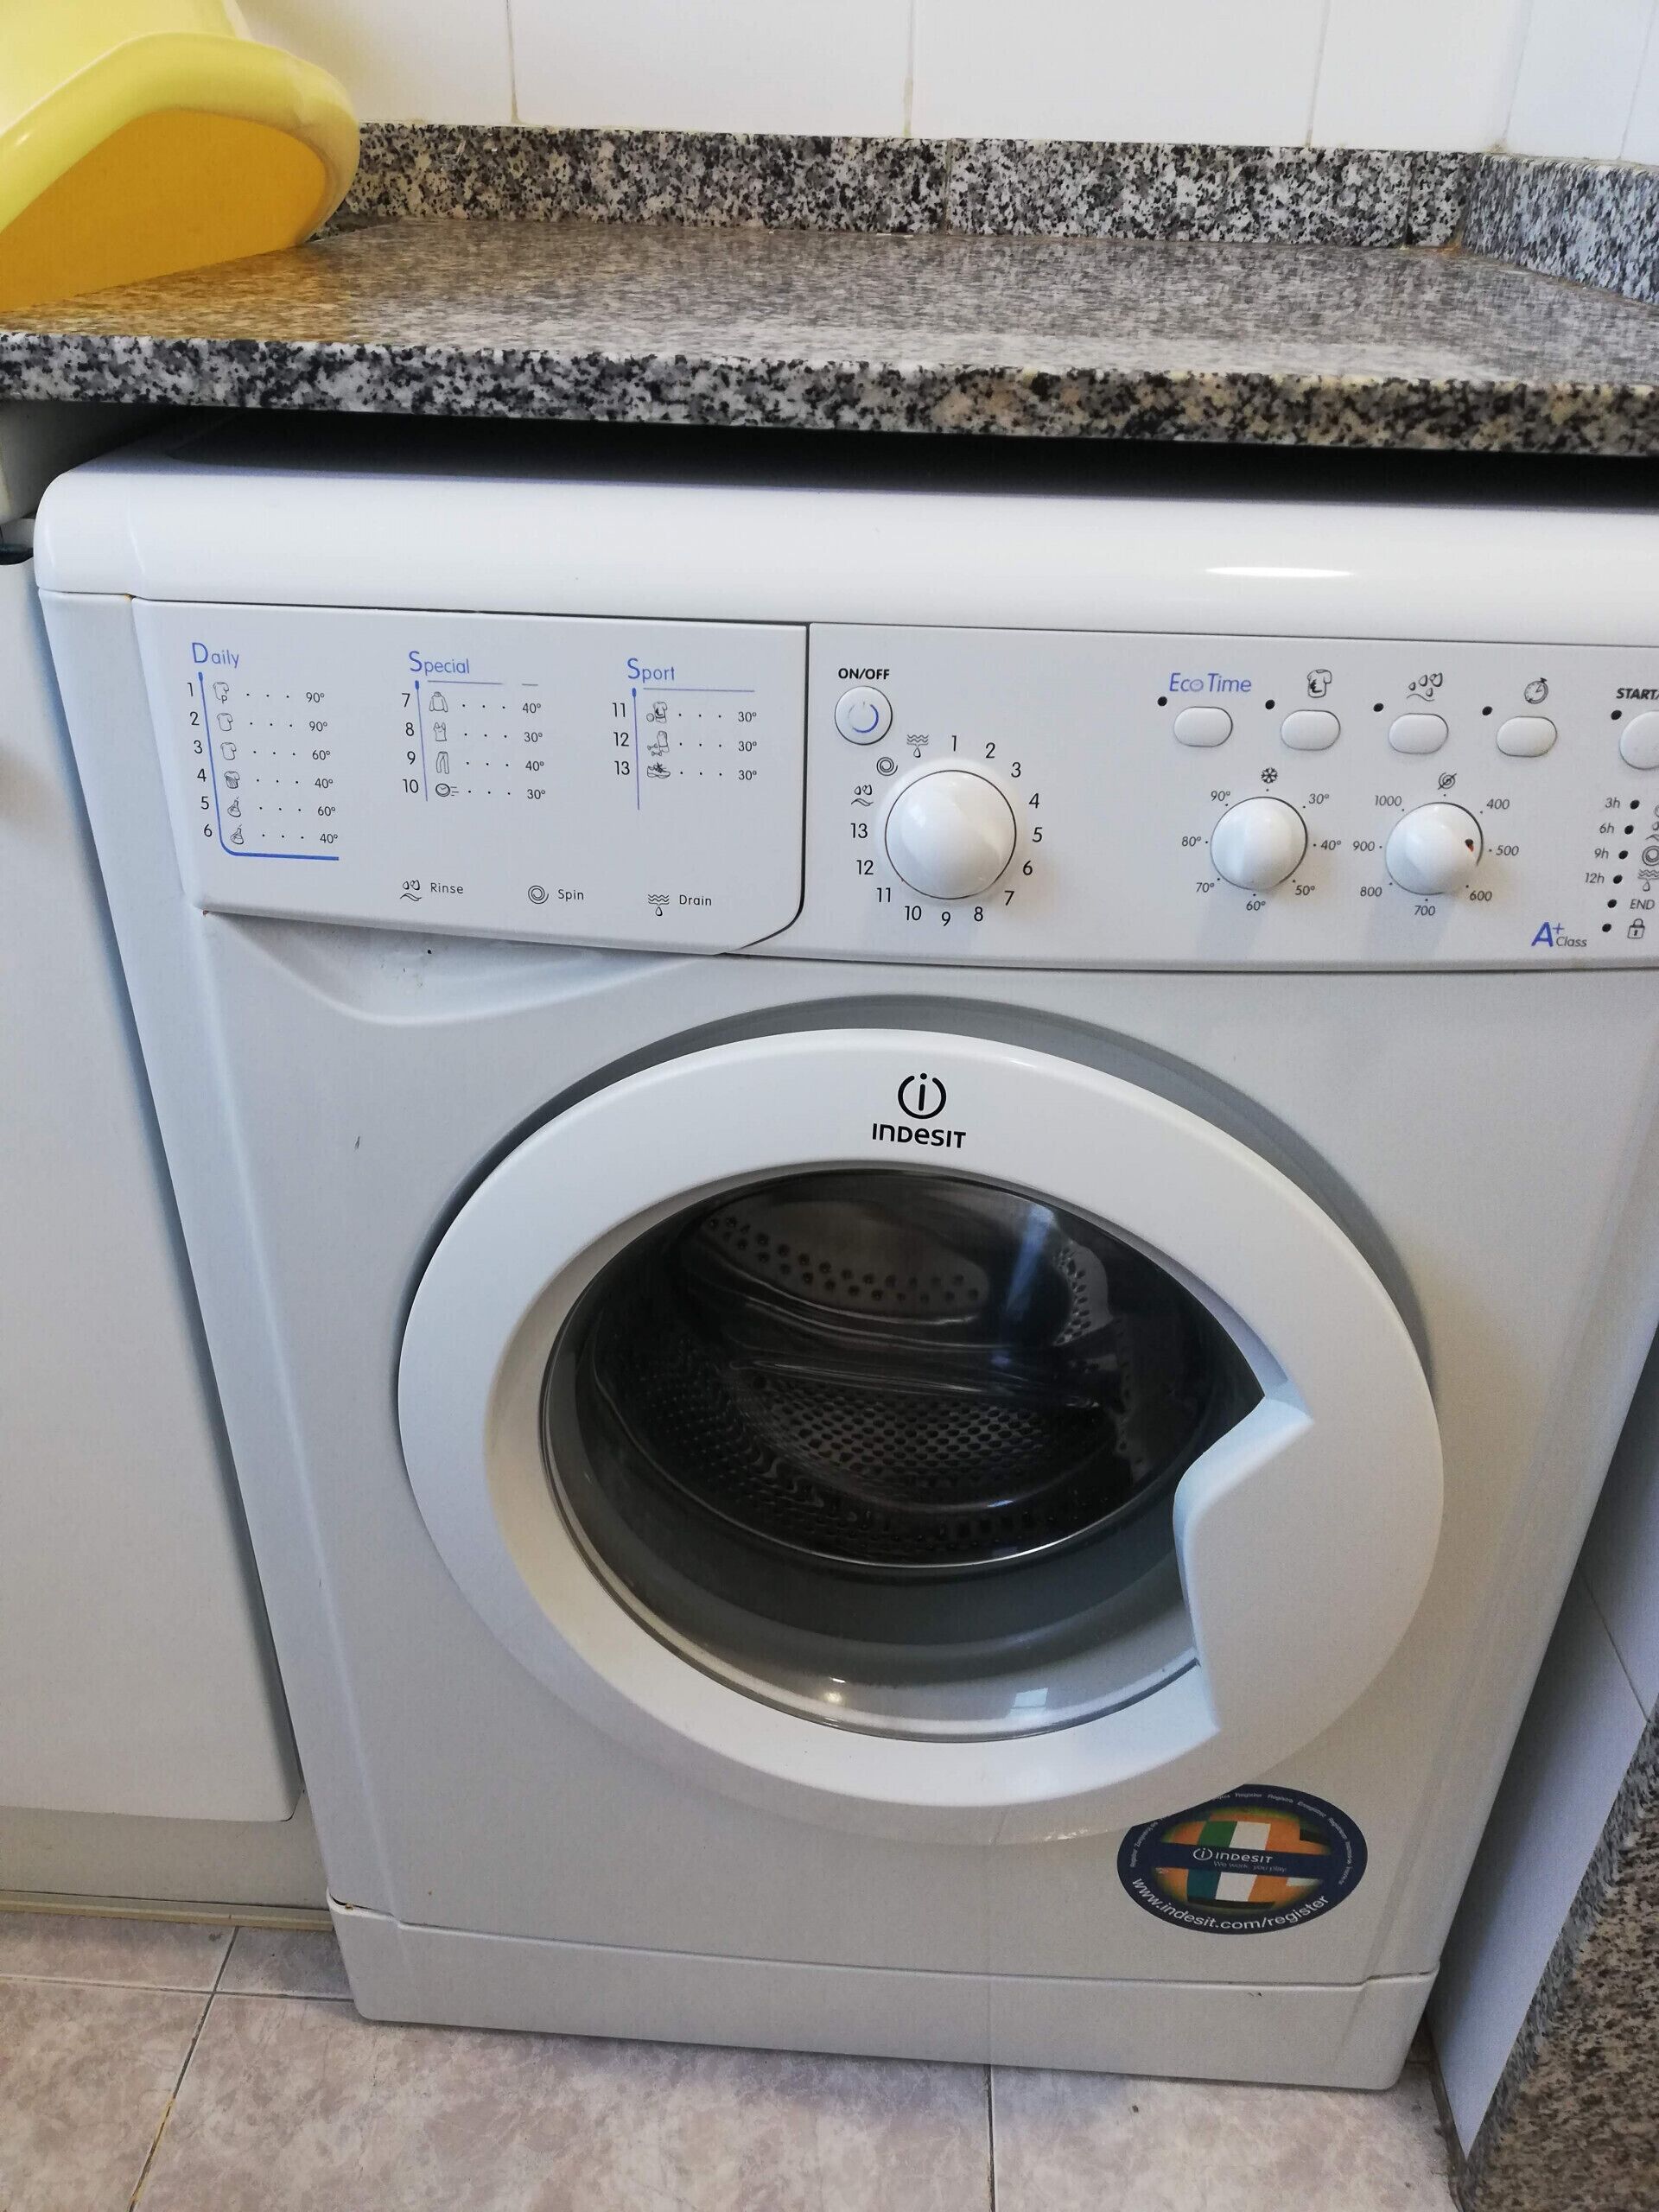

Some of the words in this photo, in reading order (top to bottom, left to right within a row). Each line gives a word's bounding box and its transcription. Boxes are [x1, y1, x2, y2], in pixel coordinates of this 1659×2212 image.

[191, 641, 239, 669] Daily
[408, 650, 470, 677] Special
[626, 657, 675, 683] Sport
[837, 667, 890, 680] ON/OFF
[187, 682, 194, 697] 1
[401, 692, 411, 709] 7
[612, 702, 626, 718] 11
[189, 711, 200, 726] 2
[405, 721, 415, 737] 8
[194, 739, 203, 754] 3
[613, 731, 630, 747] 12
[951, 734, 957, 753] 1
[406, 750, 416, 766] 9
[985, 741, 996, 760] 2
[196, 768, 207, 783] 4
[613, 760, 631, 776] 13
[1010, 761, 1021, 779] 3
[402, 779, 419, 794] 10
[200, 795, 210, 810] 5
[1028, 792, 1040, 810] 4
[1375, 794, 1402, 807] 1000
[1485, 798, 1510, 810] 400
[1605, 797, 1621, 809] 3h
[203, 823, 213, 838] 6
[850, 822, 868, 839] 13
[1032, 826, 1043, 843] 5
[1599, 822, 1615, 835] 6h
[1352, 840, 1376, 852] 900
[1495, 844, 1520, 857] 500
[1593, 847, 1610, 860] 9h
[855, 859, 874, 875] 12
[1022, 860, 1033, 876] 6
[1585, 872, 1605, 884] 12h
[430, 882, 464, 894] Rinse
[557, 888, 584, 902] Spin
[876, 887, 891, 903] 11
[1359, 886, 1383, 898] 800
[1469, 889, 1493, 902] 600
[679, 894, 712, 906] Drain
[1004, 890, 1015, 906] 7
[1629, 898, 1656, 911] END
[904, 905, 922, 921] 10
[973, 906, 984, 923] 8
[1414, 905, 1436, 917] 700
[941, 911, 951, 927] 9
[1555, 936, 1587, 948] Class
[1132, 1878, 1330, 1929] www.indesit.com/register
